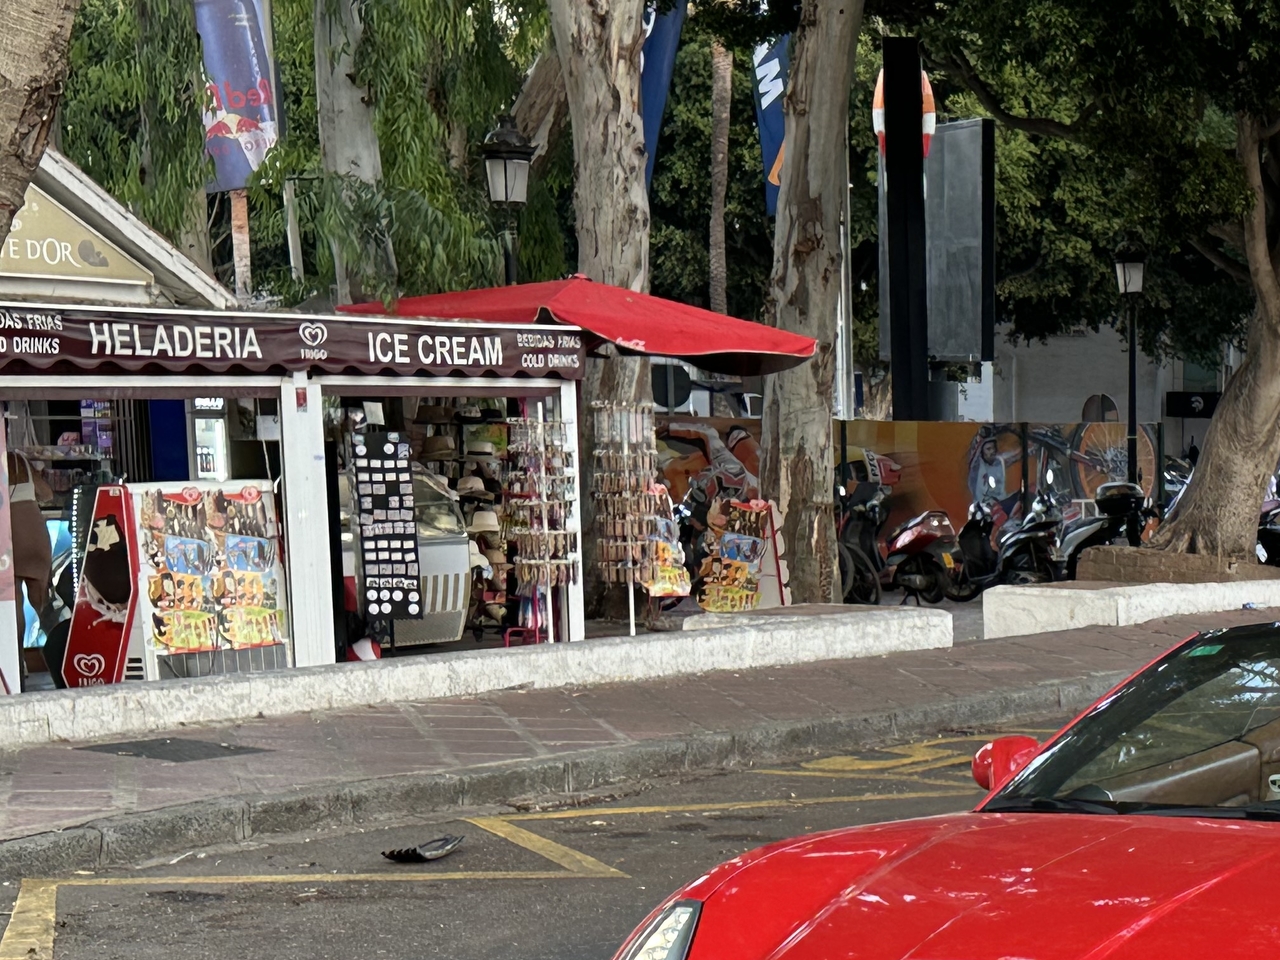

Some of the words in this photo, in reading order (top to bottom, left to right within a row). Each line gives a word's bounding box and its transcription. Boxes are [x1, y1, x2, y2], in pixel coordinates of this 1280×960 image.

[13, 336, 60, 355] DRINKS
[89, 322, 263, 359] HELADERIA
[368, 331, 411, 364] ICE
[417, 335, 503, 366] CREAM
[521, 353, 545, 368] COLD
[547, 354, 580, 368] DRINKS
